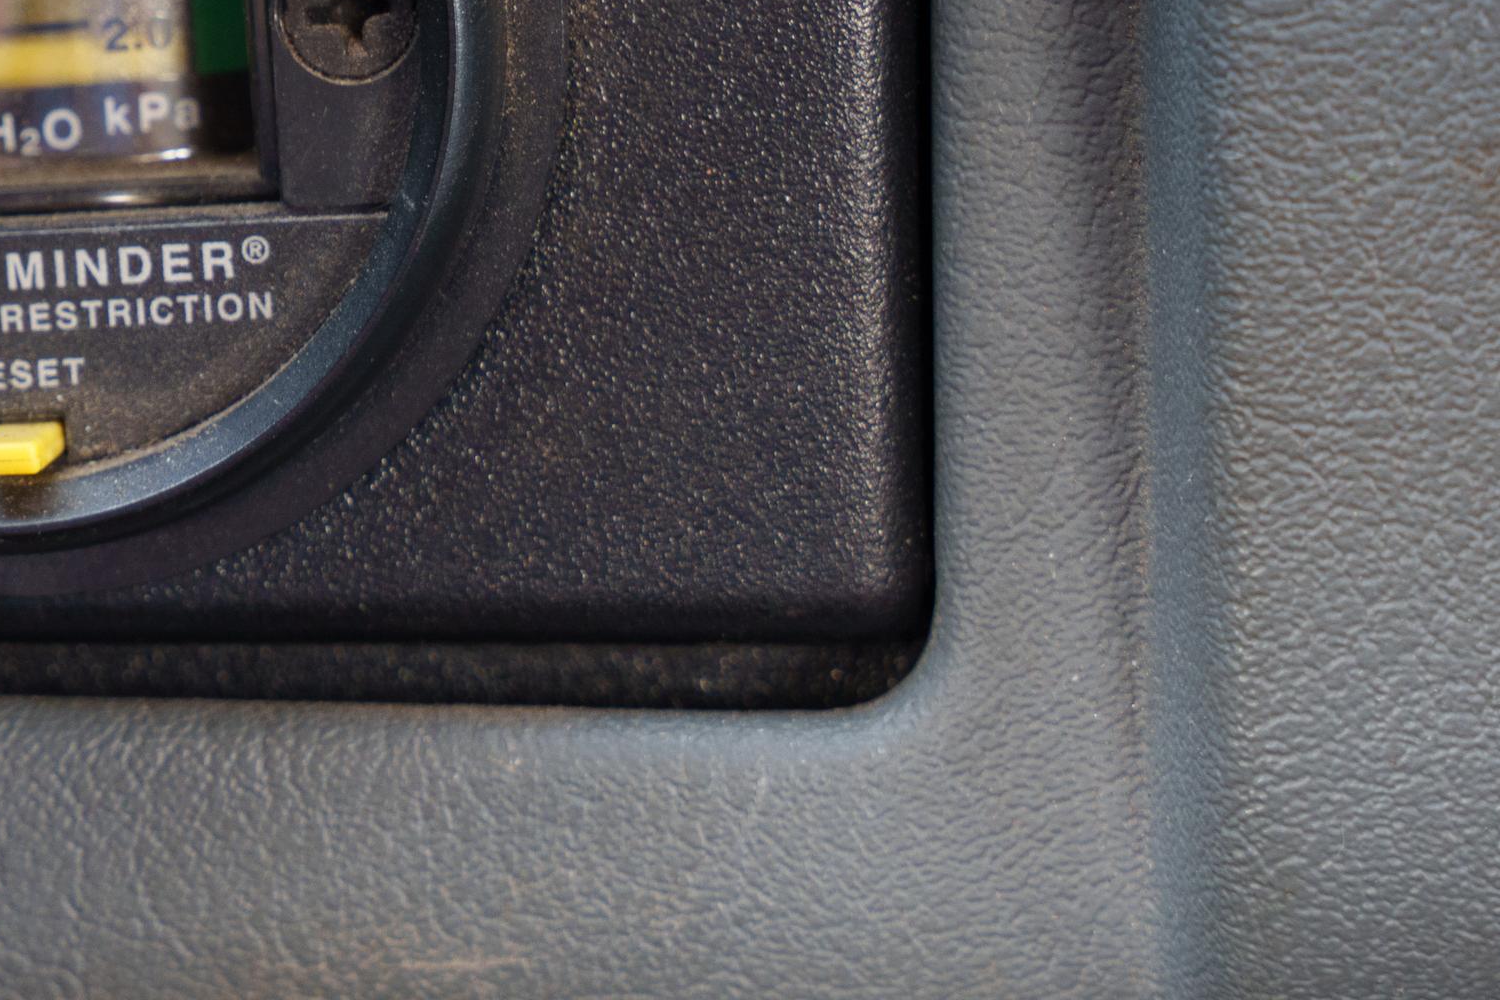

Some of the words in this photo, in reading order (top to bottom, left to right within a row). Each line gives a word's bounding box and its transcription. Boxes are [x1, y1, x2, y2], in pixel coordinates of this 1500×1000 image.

[102, 12, 173, 53] 2.0
[103, 91, 201, 137] kPa
[0, 290, 275, 334] RESTRICTION
